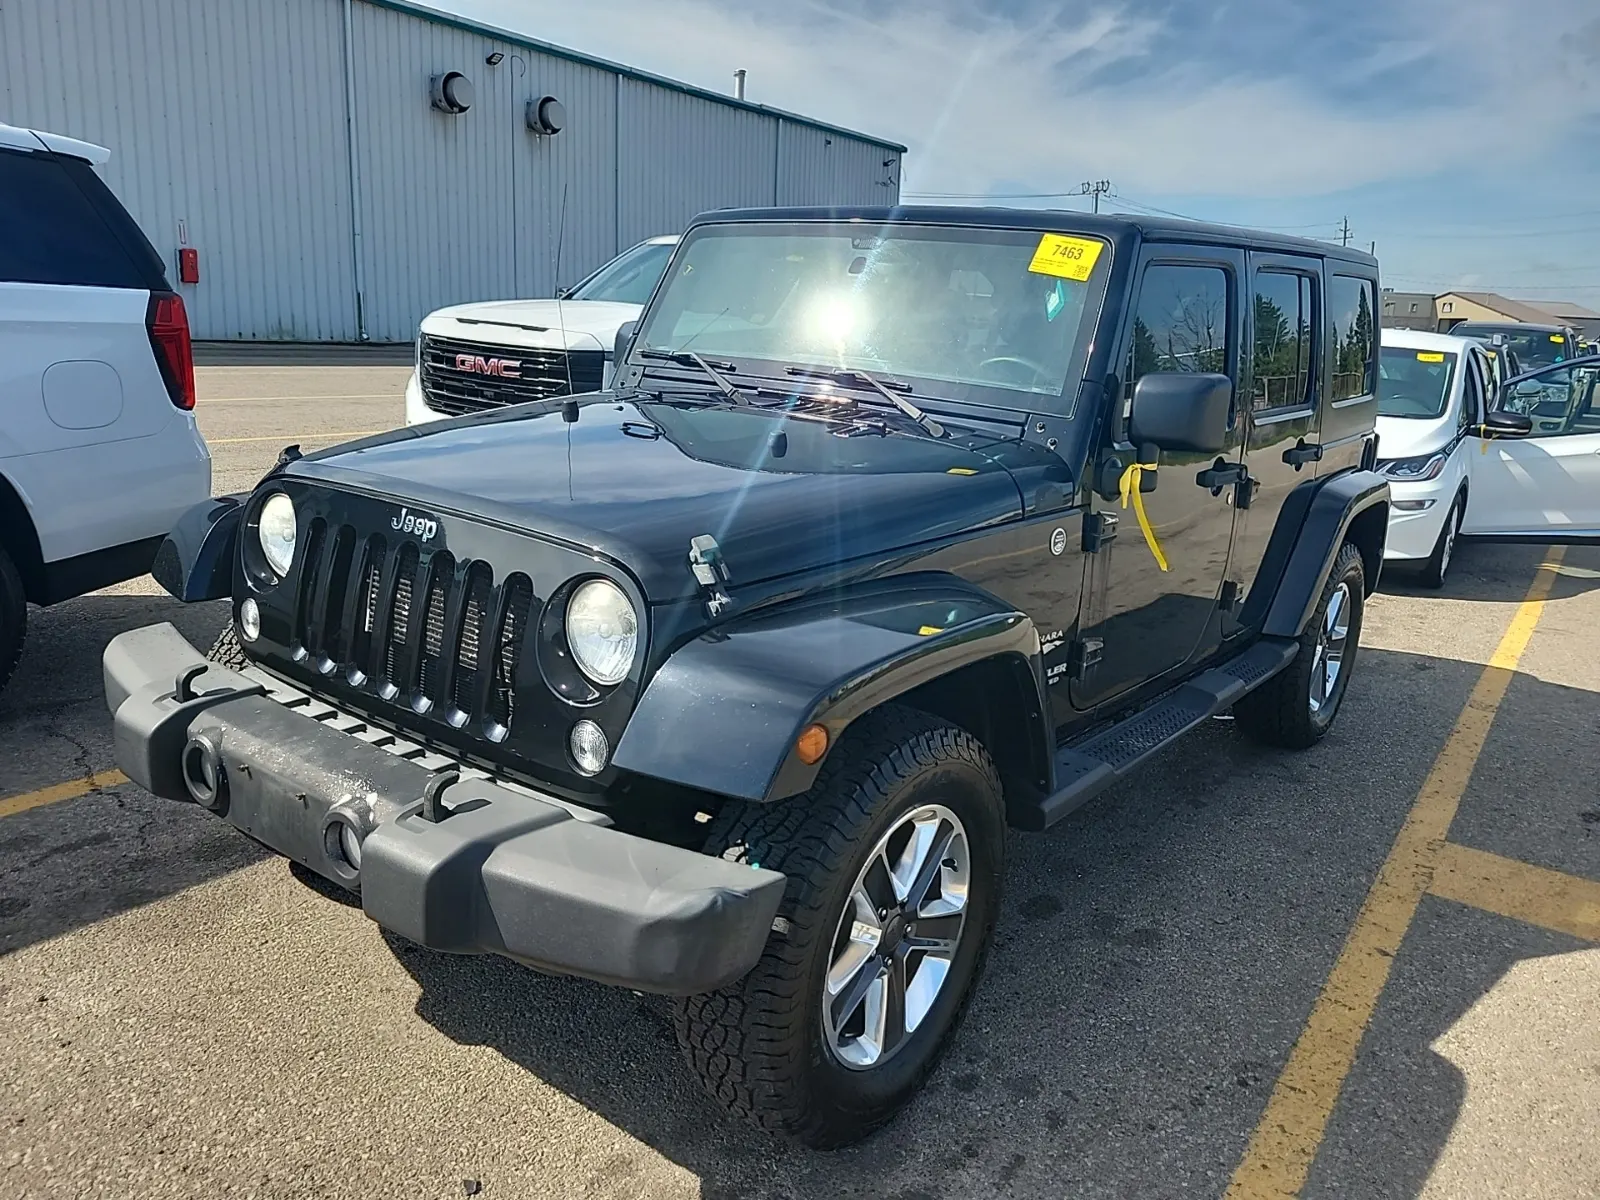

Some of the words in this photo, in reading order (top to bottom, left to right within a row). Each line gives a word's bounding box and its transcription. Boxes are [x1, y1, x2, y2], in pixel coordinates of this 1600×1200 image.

[1052, 244, 1084, 260] 7463
[455, 353, 522, 379] GMC
[391, 507, 437, 543] Jeep
